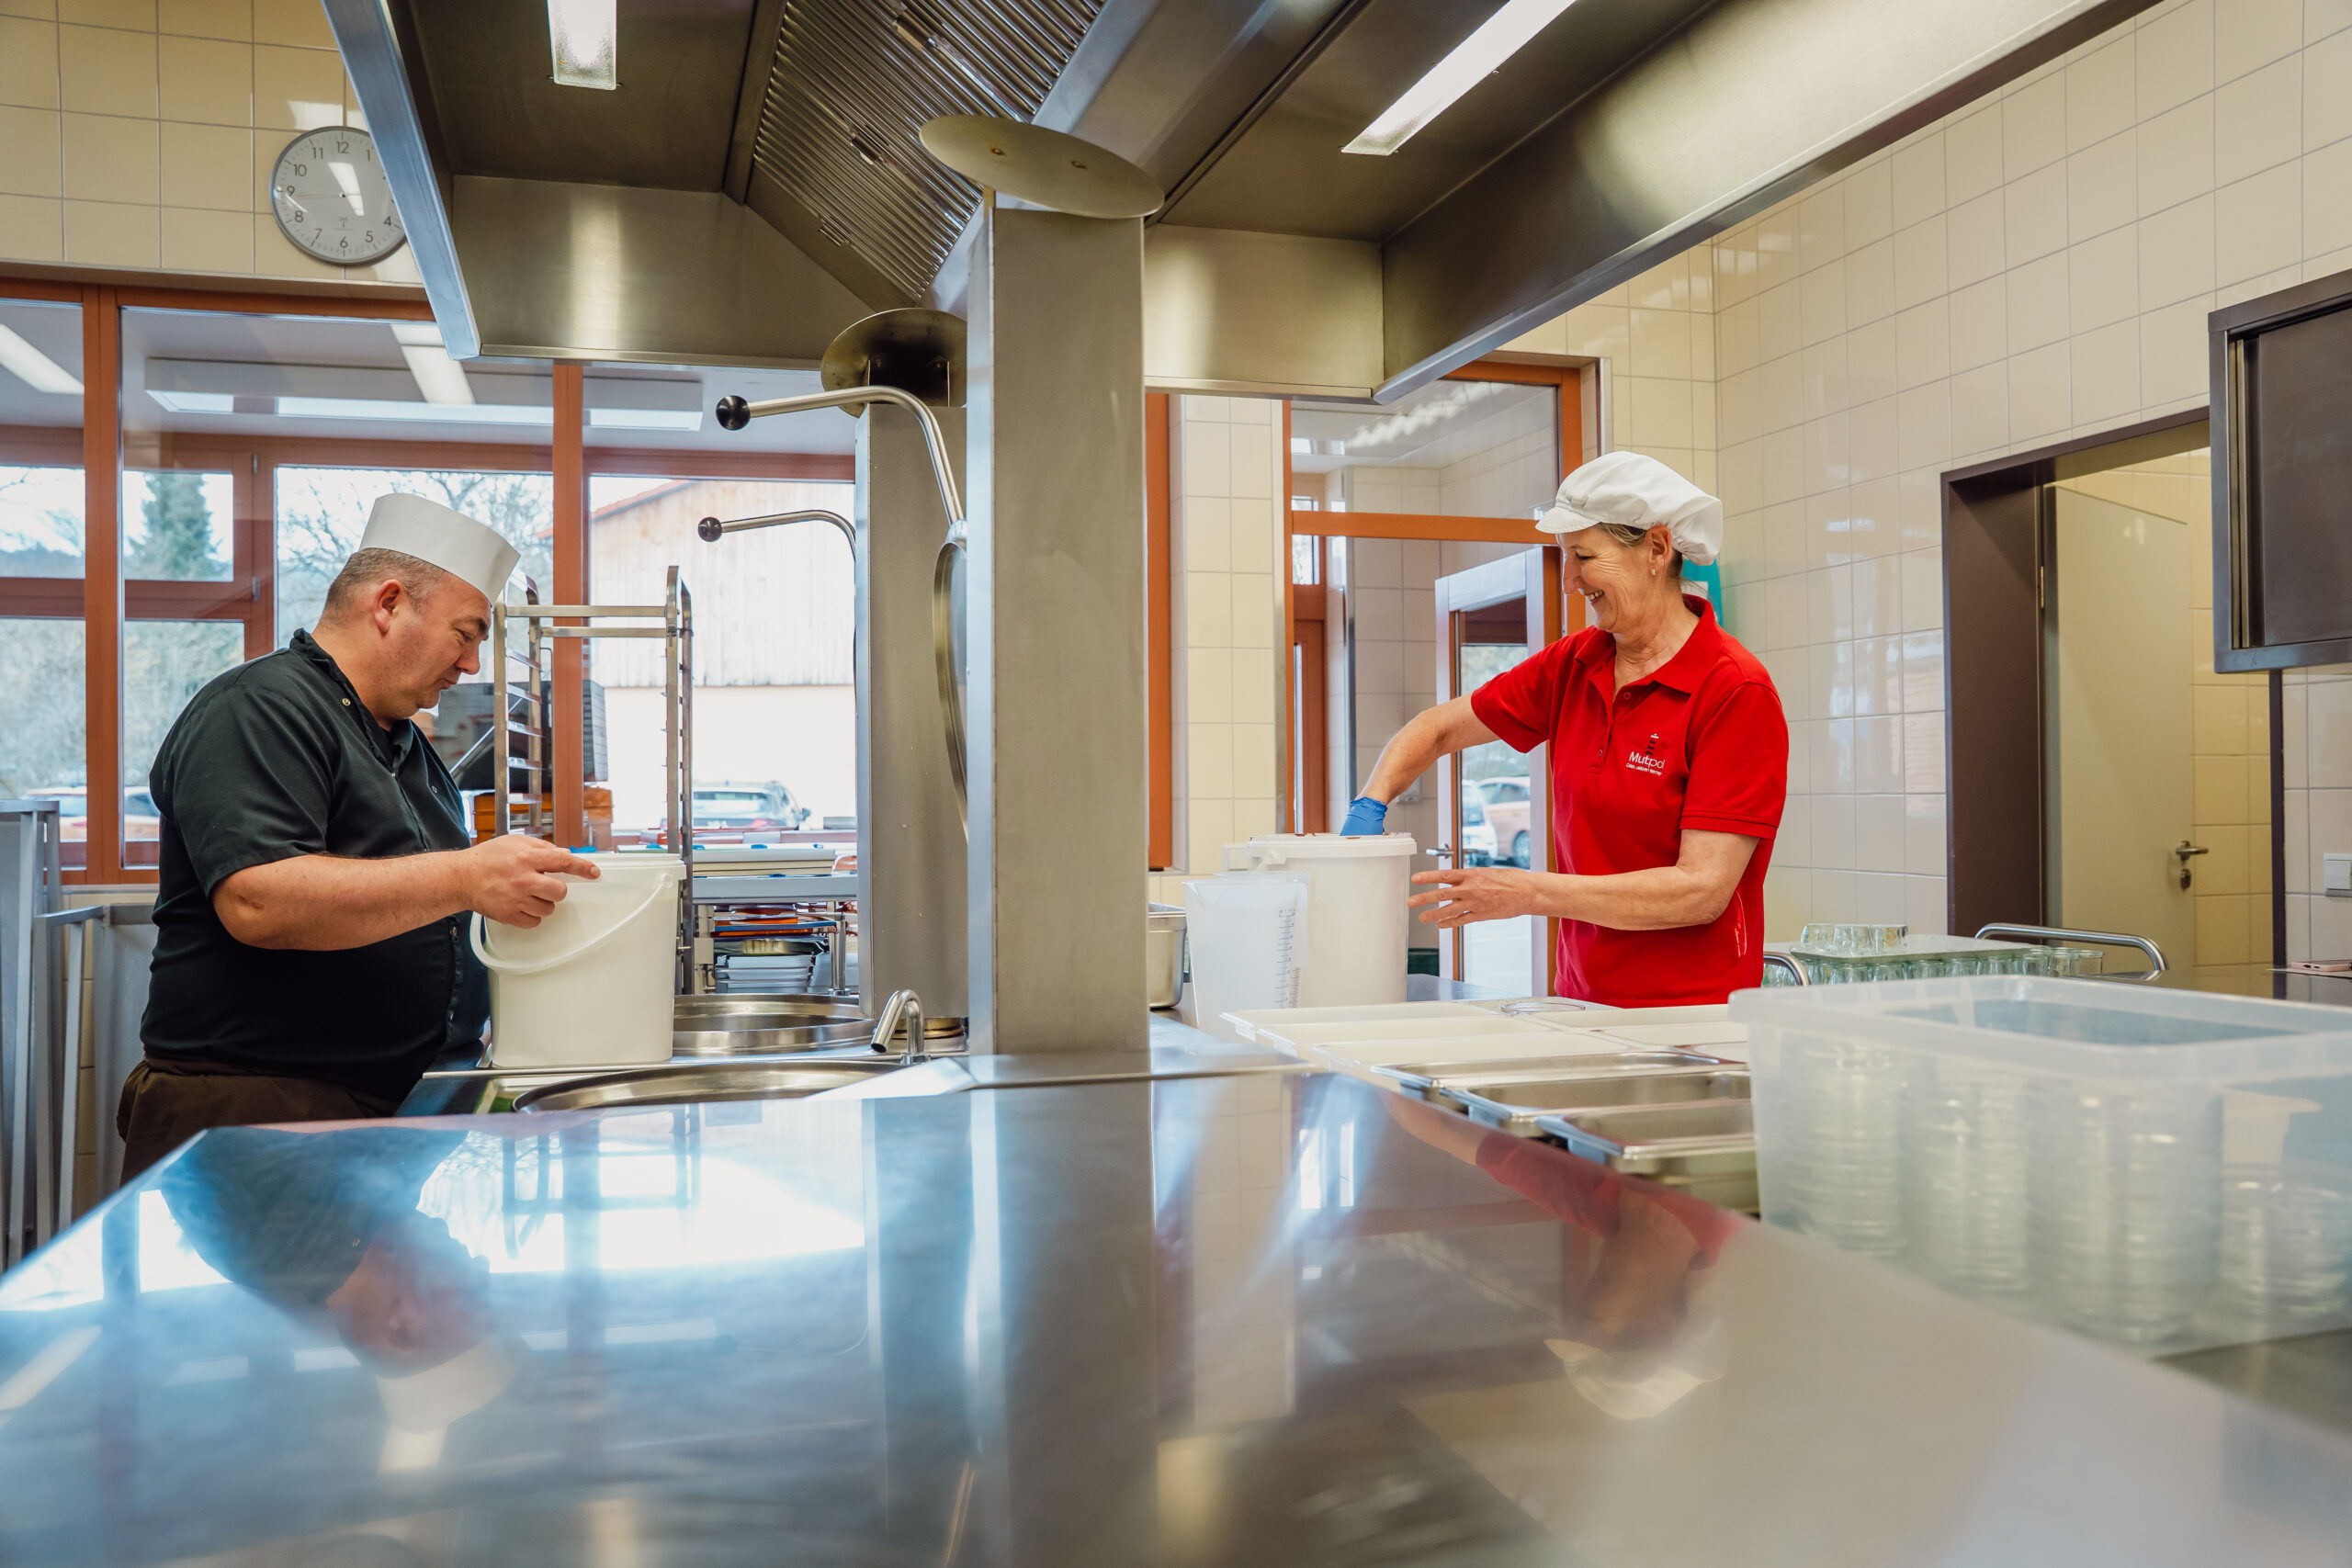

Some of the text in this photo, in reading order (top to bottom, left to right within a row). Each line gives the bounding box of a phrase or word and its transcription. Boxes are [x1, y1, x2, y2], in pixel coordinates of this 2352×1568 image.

[337, 141, 349, 153] 12
[312, 147, 323, 160] 11
[367, 150, 371, 162] 1
[293, 164, 308, 177] 10
[287, 185, 295, 197] 9
[295, 210, 303, 222] 8
[383, 215, 392, 227] 4
[314, 228, 322, 240] 7
[365, 231, 374, 243] 5
[340, 236, 348, 248] 6
